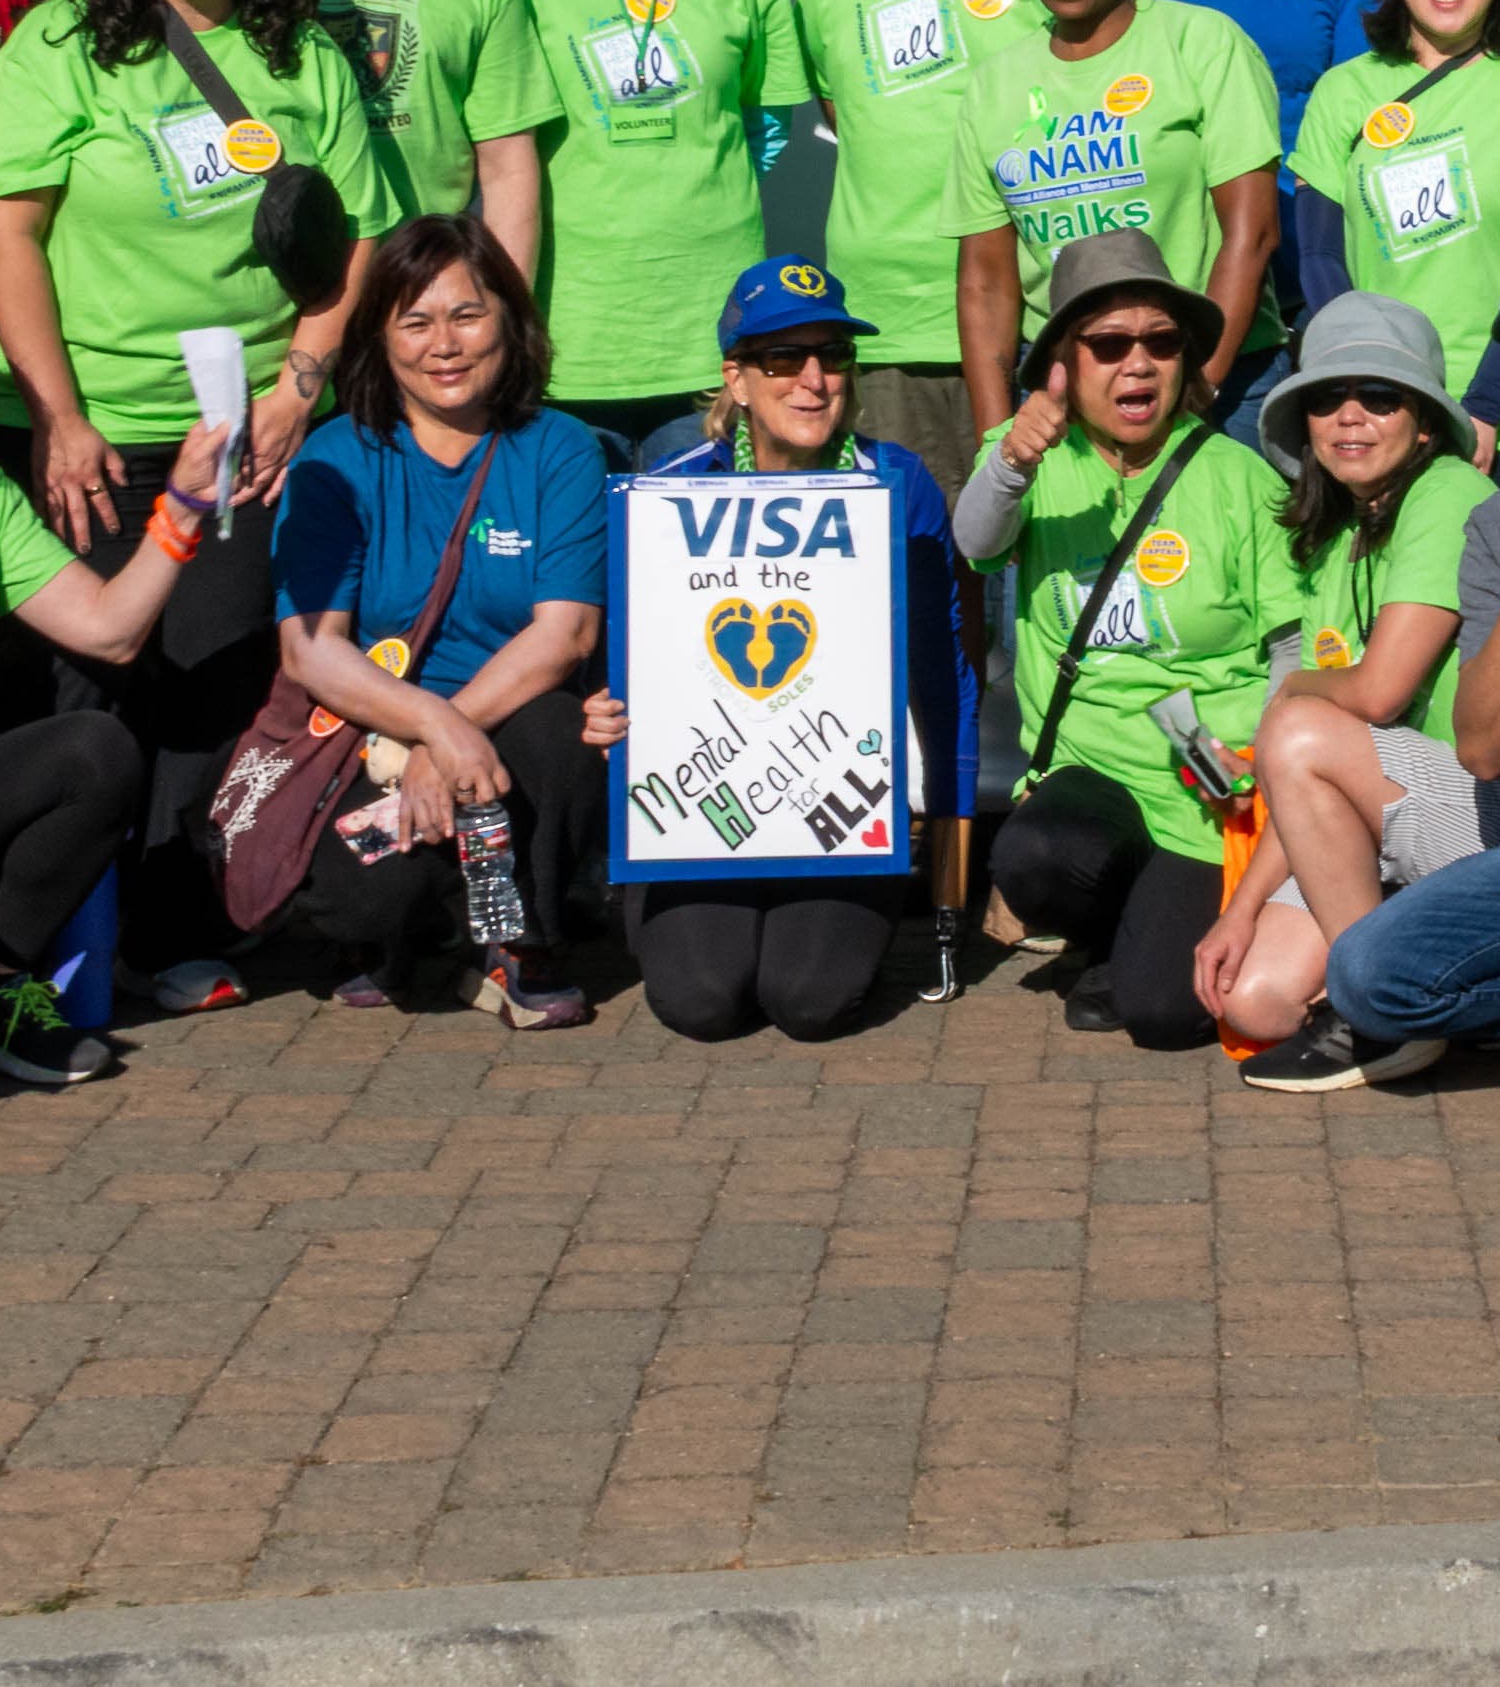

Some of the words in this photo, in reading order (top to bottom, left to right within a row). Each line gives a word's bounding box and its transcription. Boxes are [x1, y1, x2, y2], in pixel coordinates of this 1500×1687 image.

[894, 18, 944, 67] all
[615, 116, 673, 131] VOLUNTEER
[1028, 134, 1140, 182] NAMI
[1013, 200, 1151, 245] Walks
[1400, 178, 1453, 230] all
[661, 496, 856, 558] VISA
[689, 564, 739, 591] and
[758, 563, 812, 591] the
[1094, 598, 1145, 648] all
[767, 674, 815, 713] SOLES
[698, 709, 850, 852] Health
[788, 777, 823, 813] for
